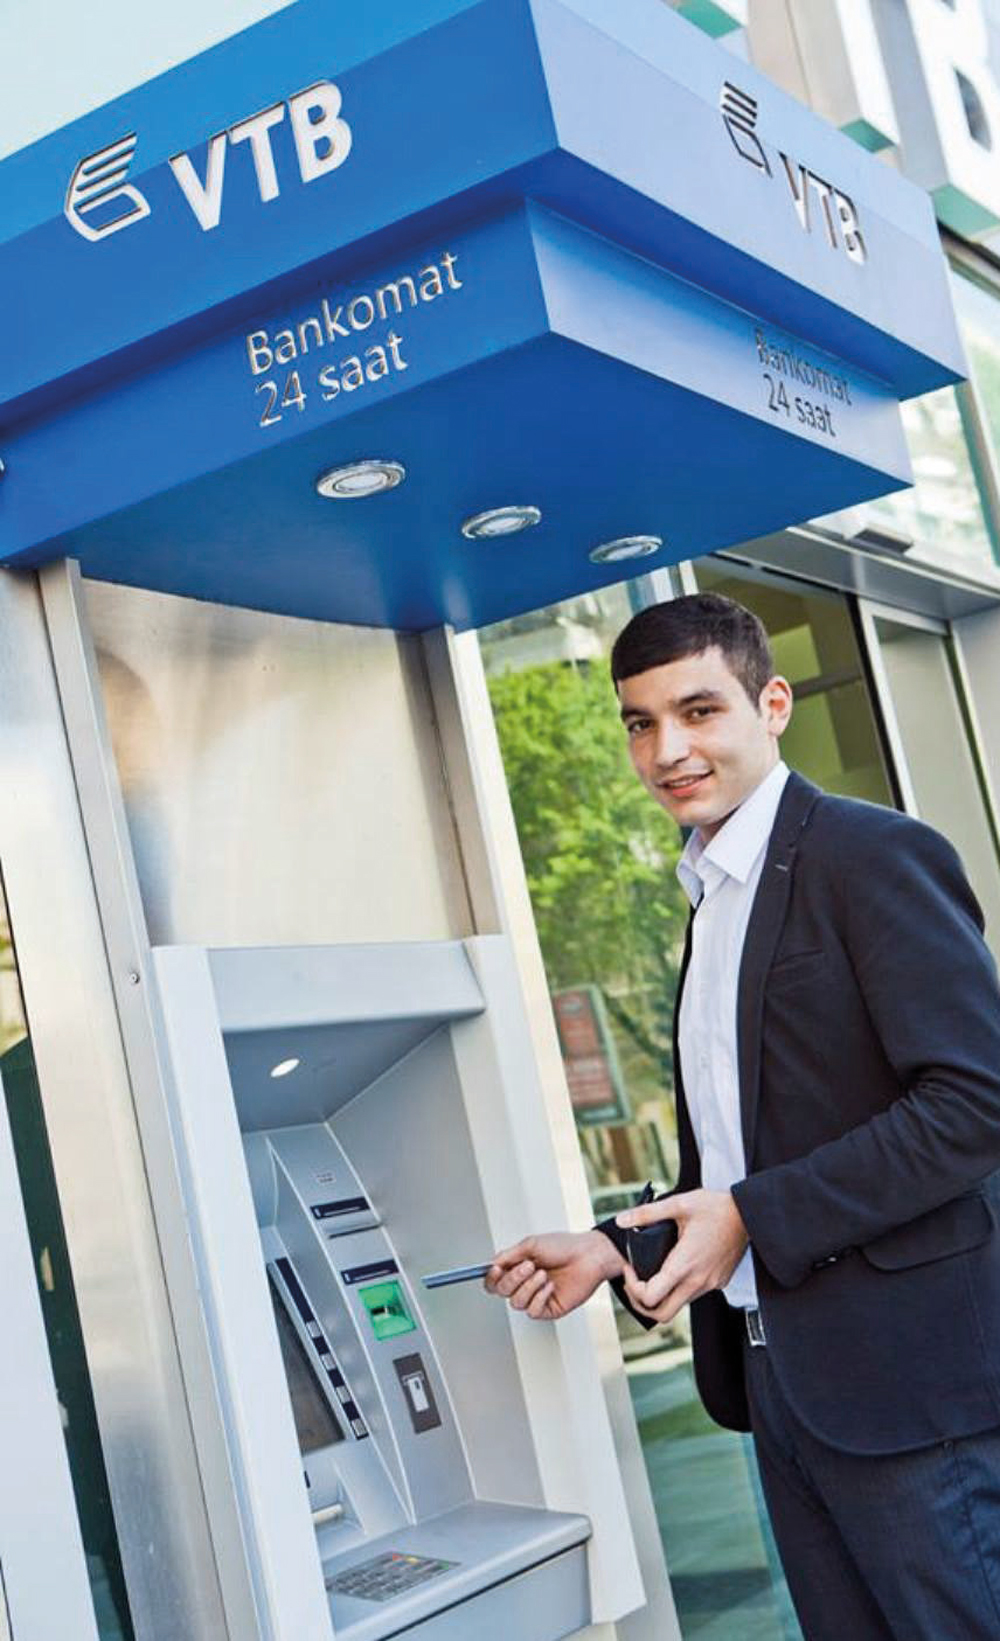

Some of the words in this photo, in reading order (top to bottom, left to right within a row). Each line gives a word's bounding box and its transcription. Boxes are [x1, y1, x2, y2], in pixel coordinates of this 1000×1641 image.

[168, 79, 352, 232] VTB
[779, 151, 867, 266] VTB
[246, 251, 463, 375] Bankomat
[254, 371, 307, 428] 24
[318, 331, 408, 400] saat
[763, 373, 790, 416] 24
[795, 397, 836, 437] saat
